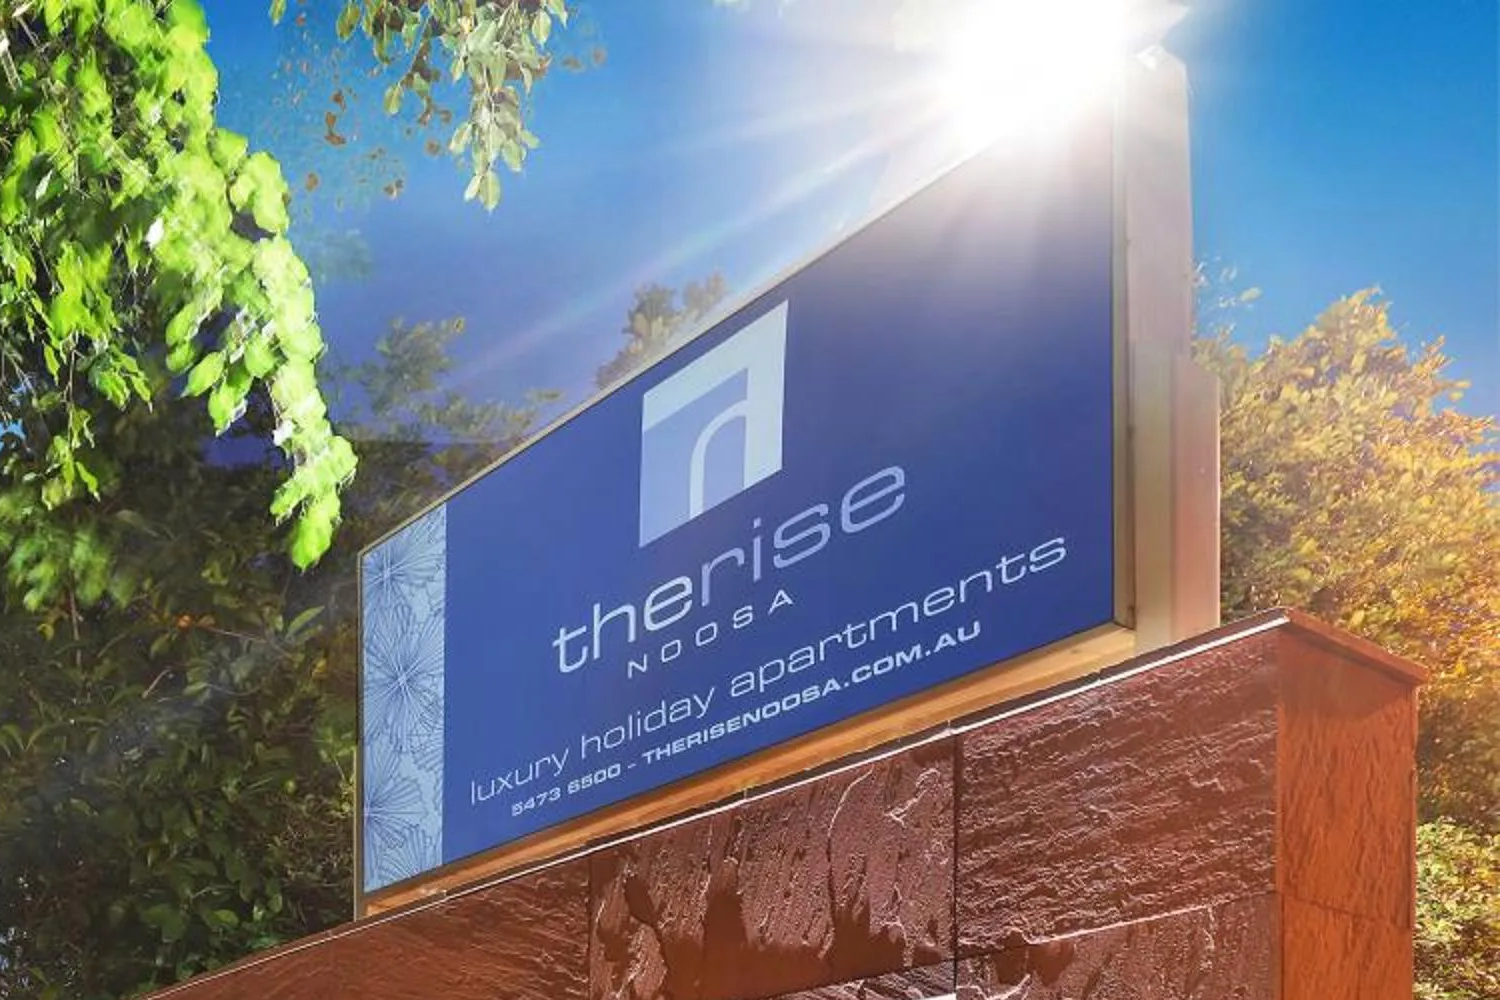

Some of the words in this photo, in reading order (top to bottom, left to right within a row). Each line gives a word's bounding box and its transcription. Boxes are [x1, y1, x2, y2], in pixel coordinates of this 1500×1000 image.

[470, 748, 569, 805] luxury
[581, 687, 715, 759] holiday
[731, 536, 1066, 697] apartments
[511, 787, 561, 816] 5473
[567, 763, 621, 795] 6500
[642, 620, 981, 764] THERISENOOSA.COM.AU
[627, 588, 795, 679] NOOSA
